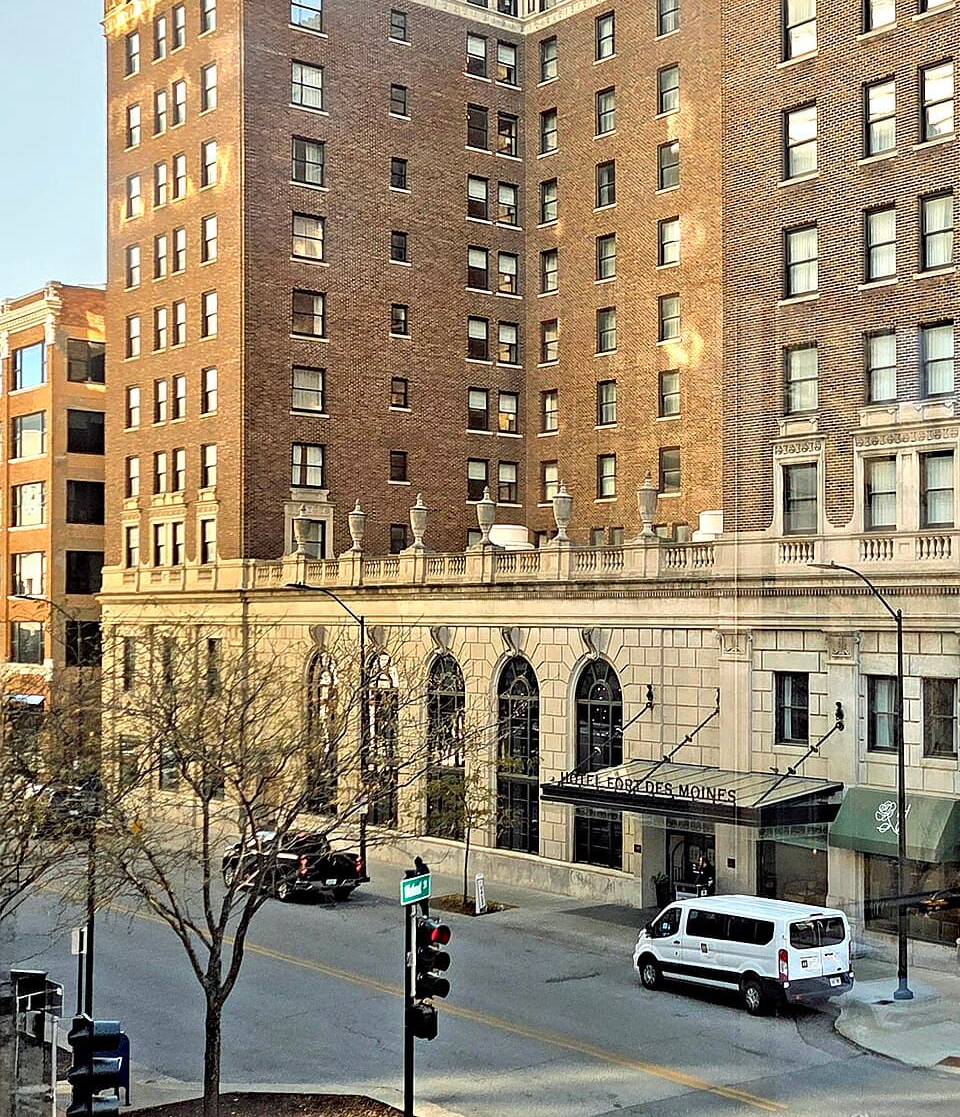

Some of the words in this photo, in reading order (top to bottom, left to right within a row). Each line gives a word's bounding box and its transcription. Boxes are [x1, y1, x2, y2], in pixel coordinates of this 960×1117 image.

[561, 771, 599, 788] HOTEL
[607, 777, 640, 792] FORT
[646, 781, 673, 795] DES
[679, 784, 736, 803] MOINES
